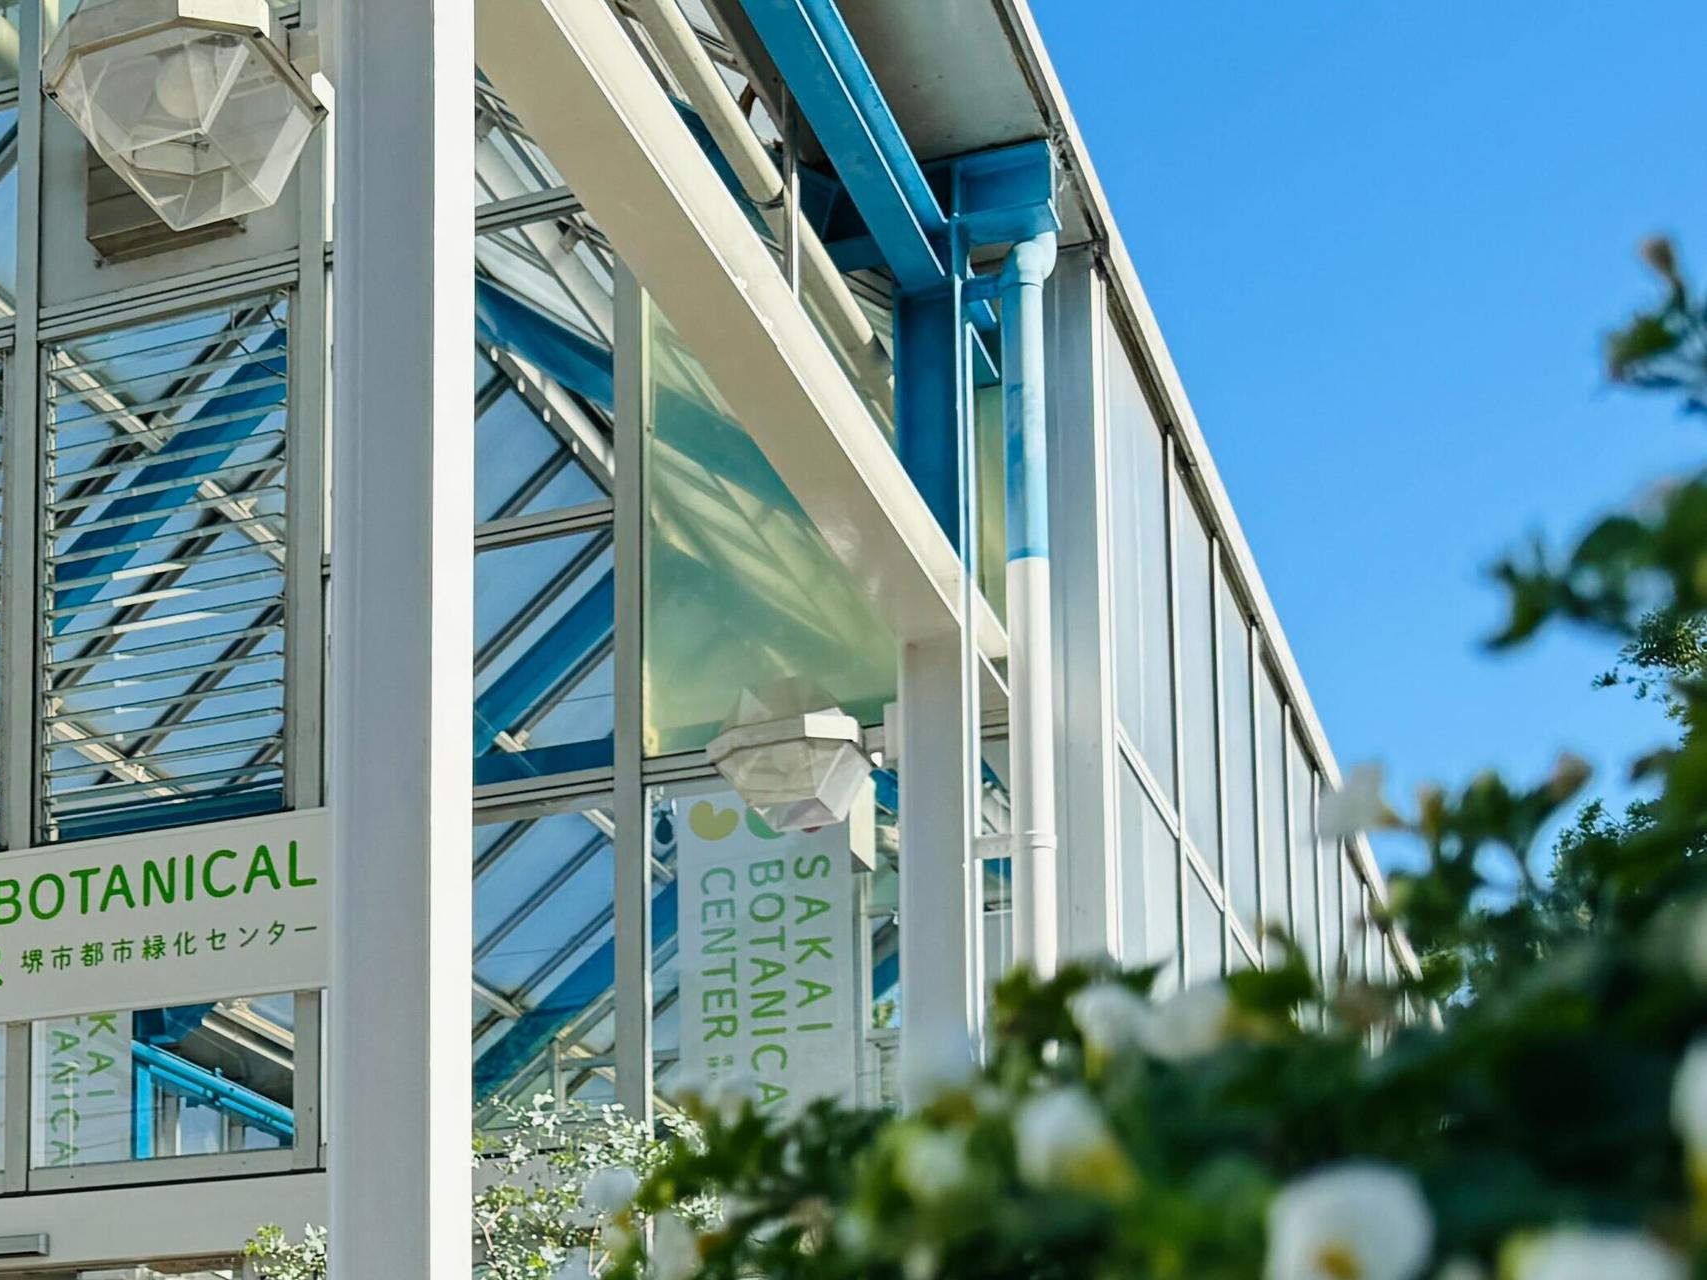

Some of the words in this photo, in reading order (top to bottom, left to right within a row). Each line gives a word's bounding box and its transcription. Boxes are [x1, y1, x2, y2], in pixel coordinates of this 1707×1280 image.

[20, 919, 318, 975] 堺市都市緑化センター
[700, 867, 739, 1043] CENTER
[793, 854, 834, 1032] SAKAI
[50, 1016, 81, 1166] ANICA
